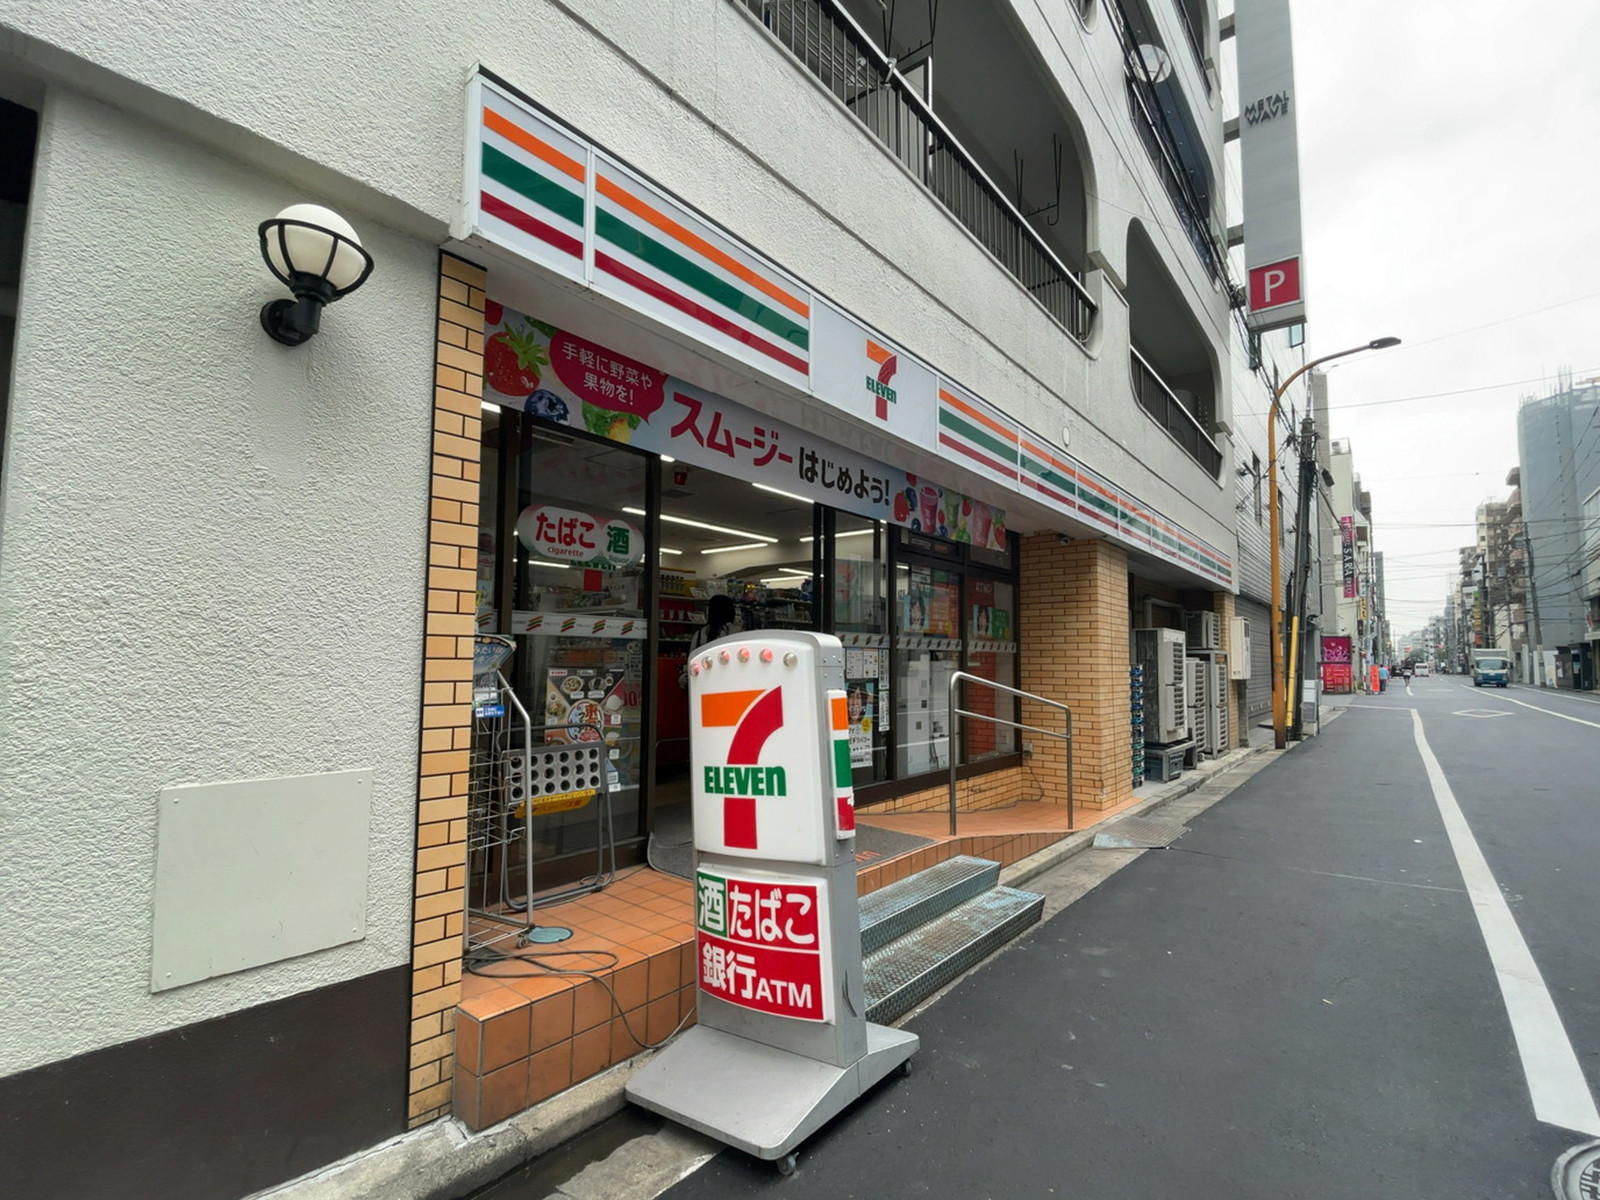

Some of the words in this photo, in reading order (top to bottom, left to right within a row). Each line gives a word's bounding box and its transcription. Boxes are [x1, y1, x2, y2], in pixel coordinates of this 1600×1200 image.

[1245, 90, 1290, 117] METAL
[1246, 102, 1289, 126] WAVE
[1264, 270, 1286, 303] P
[562, 341, 653, 390] 手軽に野菜や
[583, 372, 634, 406] 果物を!
[536, 512, 596, 549] たばこ
[607, 525, 630, 555] 酒
[547, 546, 585, 557] cigarette
[608, 554, 630, 564] liquor
[699, 876, 725, 932] 酒
[729, 885, 815, 944] たばこ
[702, 942, 757, 1000] 銀行
[755, 977, 813, 1009] ATM
